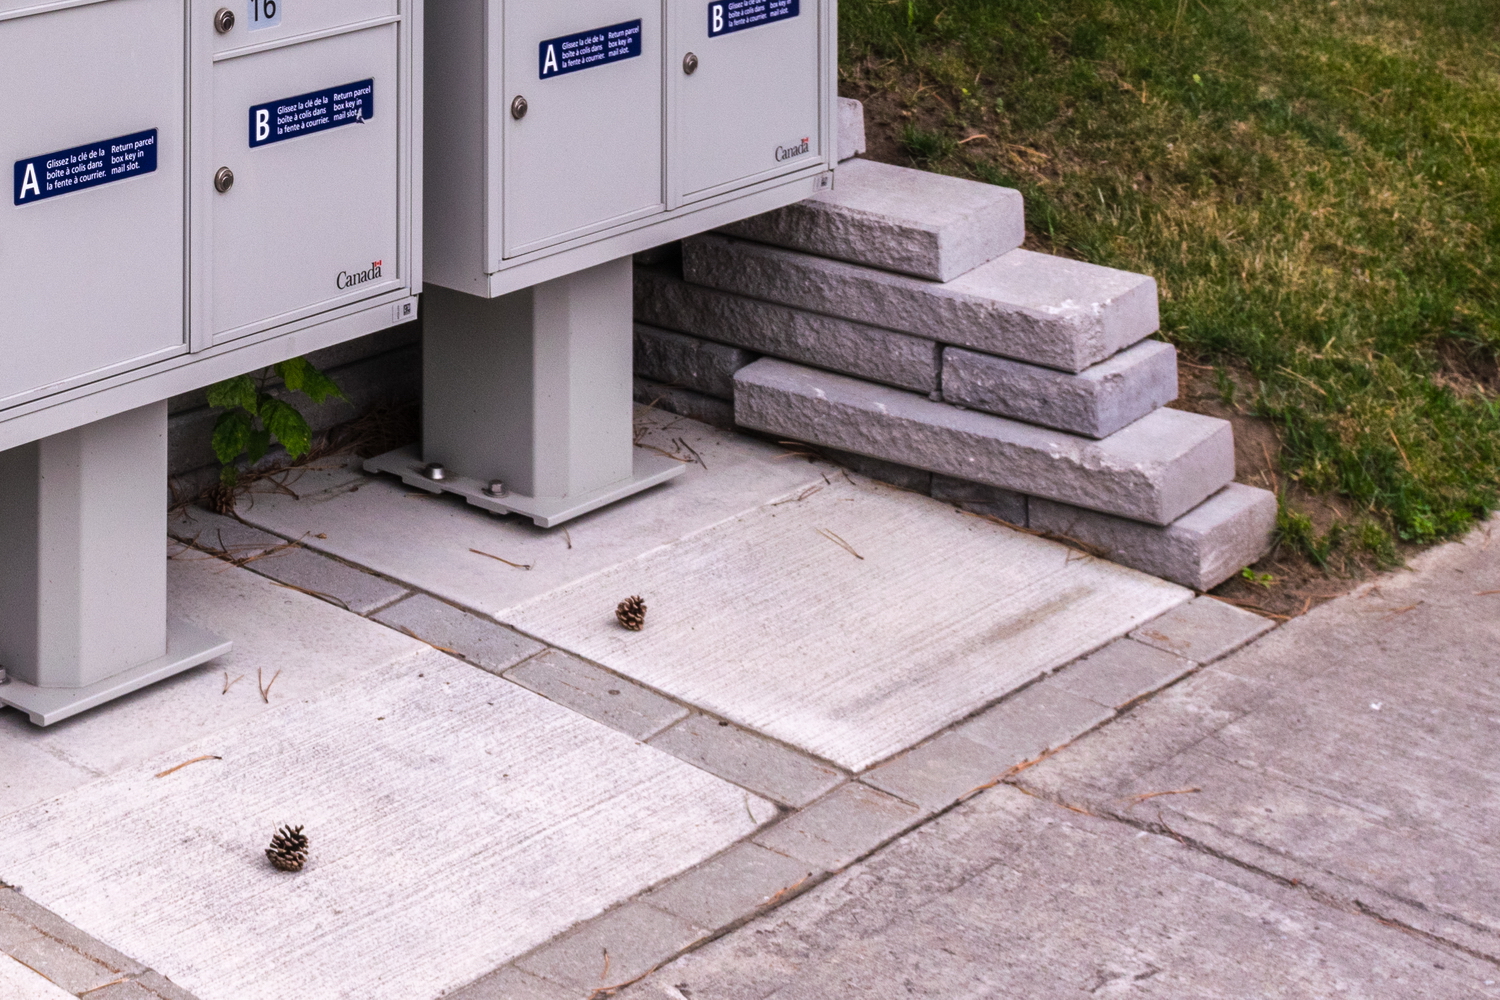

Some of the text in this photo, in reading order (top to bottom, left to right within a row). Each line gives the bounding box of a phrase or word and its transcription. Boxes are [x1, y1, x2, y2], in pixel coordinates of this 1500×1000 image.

[713, 4, 724, 32] B
[543, 44, 558, 74] A
[256, 109, 270, 141] B
[111, 136, 154, 153] Return parcel
[775, 137, 809, 162] Canada
[20, 163, 40, 199] A
[337, 260, 382, 290] Canada
